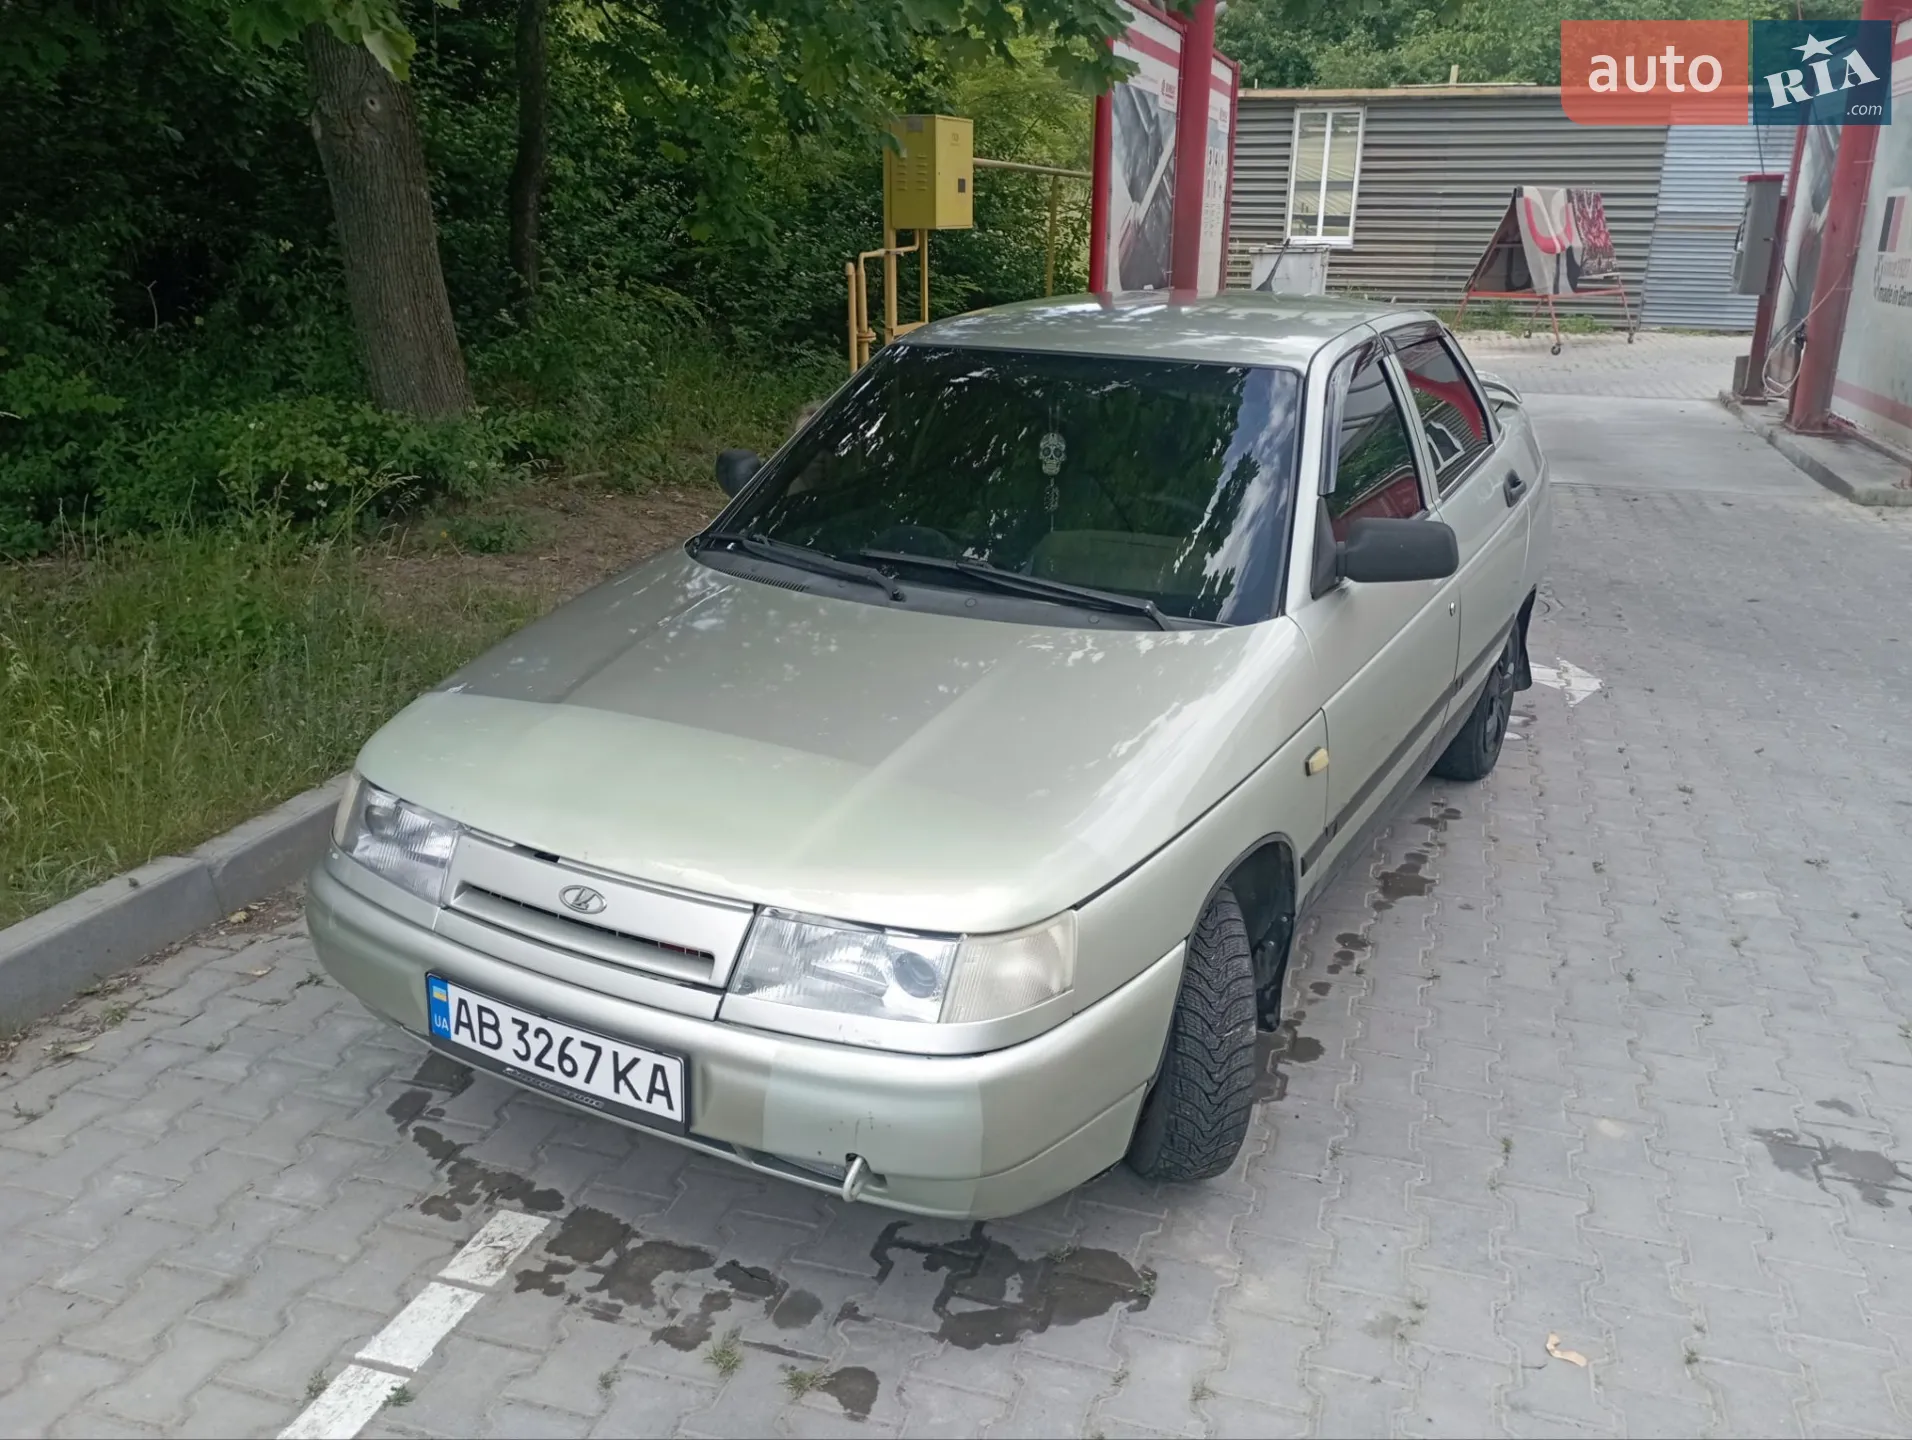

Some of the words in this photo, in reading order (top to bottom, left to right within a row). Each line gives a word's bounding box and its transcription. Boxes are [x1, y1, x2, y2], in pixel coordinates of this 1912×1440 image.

[434, 1013, 449, 1032] UA
[454, 997, 503, 1051] AB
[511, 1017, 602, 1085] 3267
[612, 1050, 675, 1112] KA
